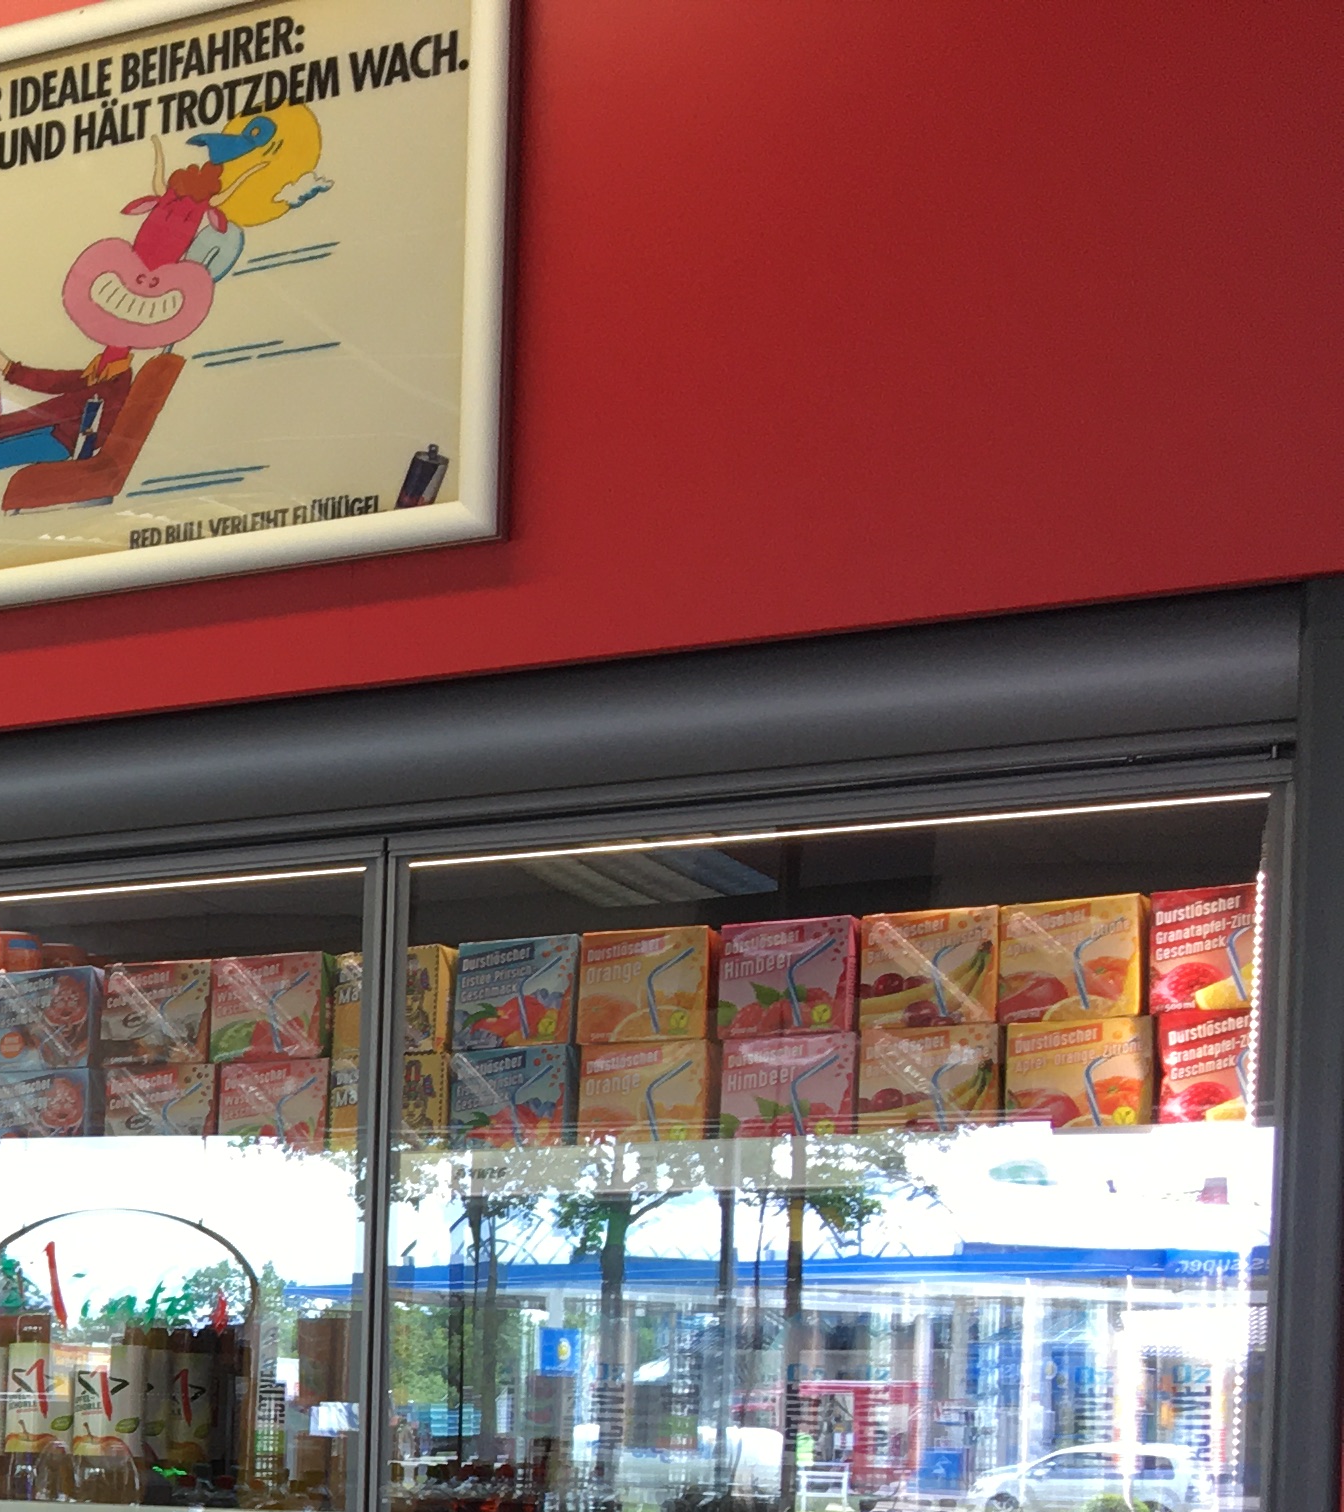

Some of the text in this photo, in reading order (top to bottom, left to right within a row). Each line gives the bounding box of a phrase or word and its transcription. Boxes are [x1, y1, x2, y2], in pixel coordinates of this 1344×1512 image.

[9, 59, 112, 118] IDEALE
[121, 16, 305, 93] BEIFAHRER:
[73, 98, 151, 156] HÄLT
[158, 59, 340, 137] TROTZDEM
[351, 30, 470, 88] WACH.
[130, 528, 161, 550] RED
[166, 519, 206, 544] BULL
[211, 507, 288, 538] VERLEIHT
[1155, 894, 1242, 926] Durstlöscher
[462, 945, 531, 972] Durstlöscher
[587, 939, 662, 962] Durstlöscher
[1155, 937, 1227, 960] Geschmack
[586, 964, 642, 986] Orange
[724, 954, 793, 980] Himbeer
[1014, 1027, 1098, 1055] Durstlöscher
[1167, 1015, 1250, 1047] Durstlöscher
[586, 1073, 641, 1096] Orange
[727, 1067, 797, 1092] Himbeer
